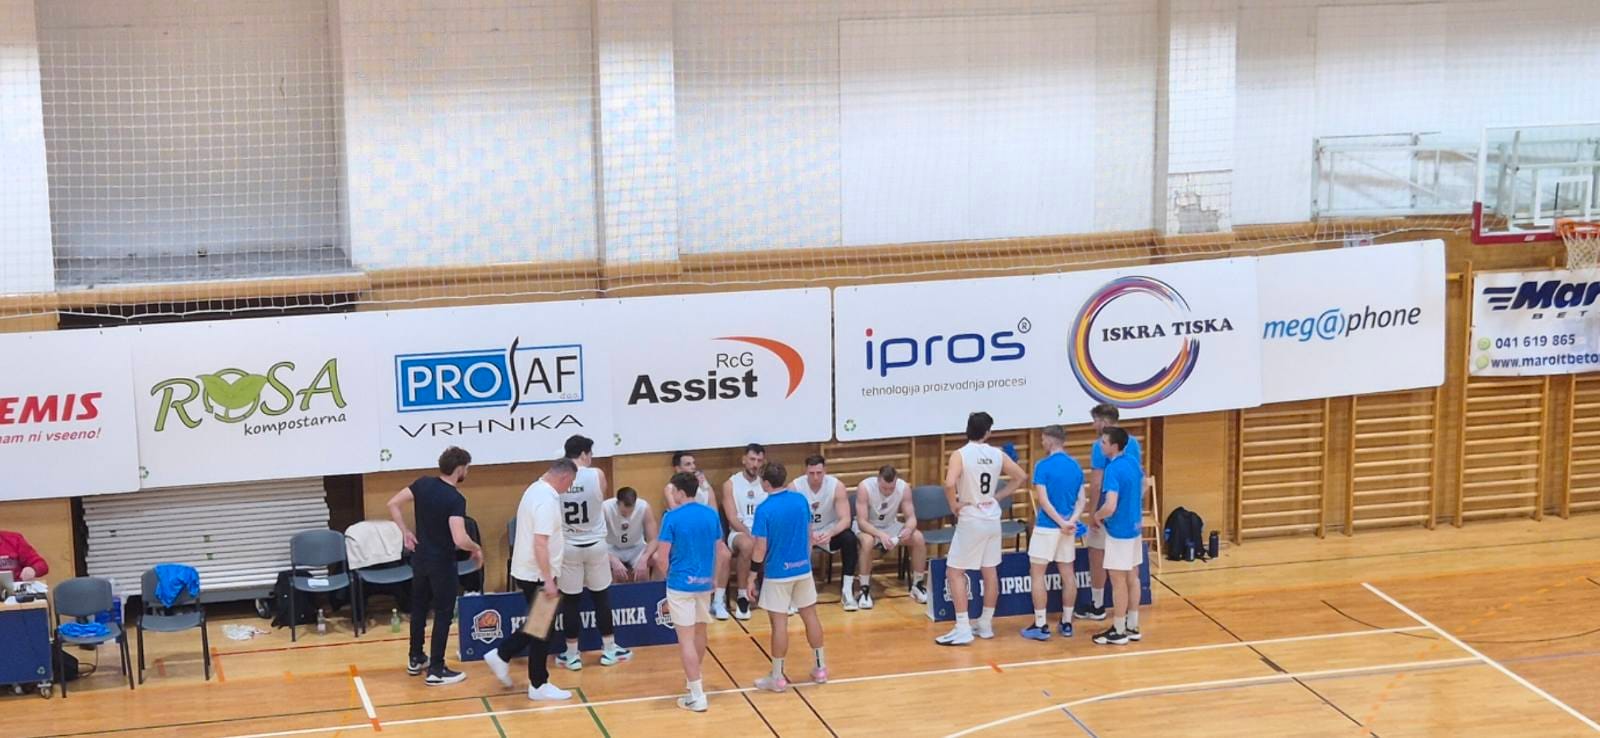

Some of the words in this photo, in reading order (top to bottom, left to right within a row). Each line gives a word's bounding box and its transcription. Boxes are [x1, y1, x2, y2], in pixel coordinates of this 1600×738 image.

[1102, 324, 1166, 342] ISKRA
[1171, 317, 1234, 336] TISKA
[864, 328, 1026, 377] ipros
[1495, 338, 1518, 349] 041
[1523, 336, 1547, 347] 619
[1552, 334, 1576, 346] 865
[716, 352, 754, 368] RcG
[150, 358, 347, 432] ROSA
[628, 369, 758, 405] Assist
[862, 385, 920, 397] tehnologija
[923, 379, 985, 393] proizvodnja
[987, 376, 1027, 389] procesi
[28, 431, 42, 442] ni
[46, 427, 102, 441] vseeno!
[243, 412, 347, 437] kompostarna
[399, 414, 584, 438] VRHNIKA
[980, 472, 991, 494] 8
[564, 500, 589, 525] 21
[621, 534, 628, 543] 6
[1001, 576, 1032, 595] IPRO
